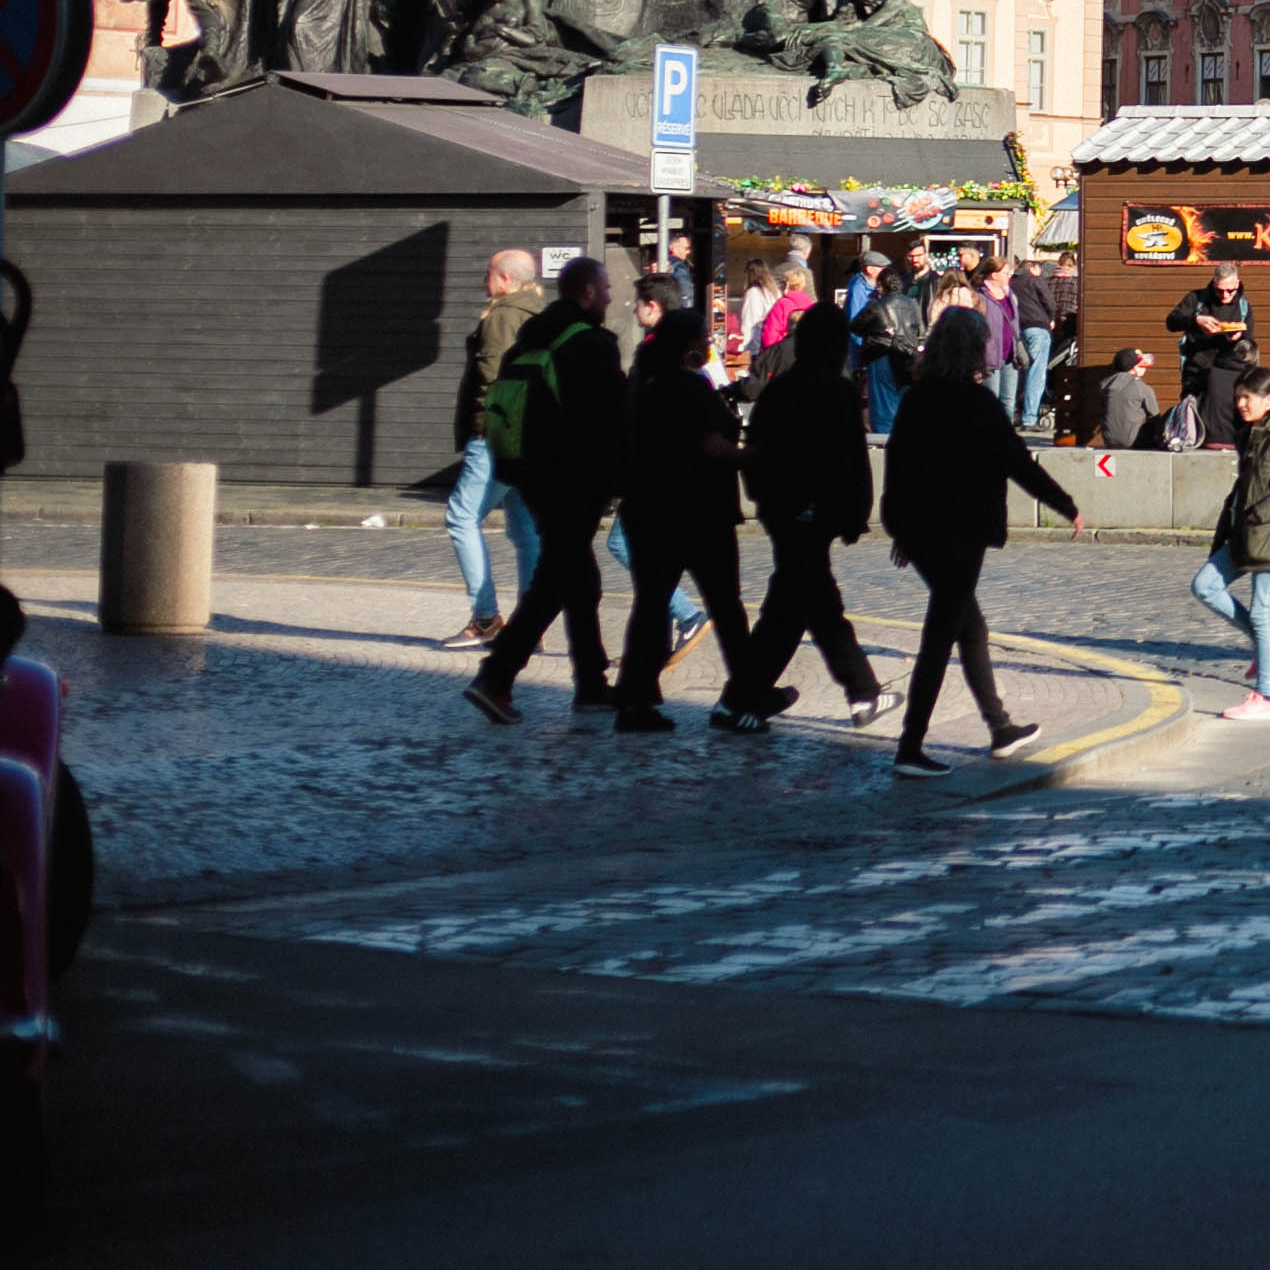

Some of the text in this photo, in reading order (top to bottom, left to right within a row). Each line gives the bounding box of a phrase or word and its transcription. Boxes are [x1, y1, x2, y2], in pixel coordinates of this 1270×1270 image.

[662, 60, 688, 115] P
[768, 208, 842, 226] BARBEQUE
[551, 252, 571, 260] WC
